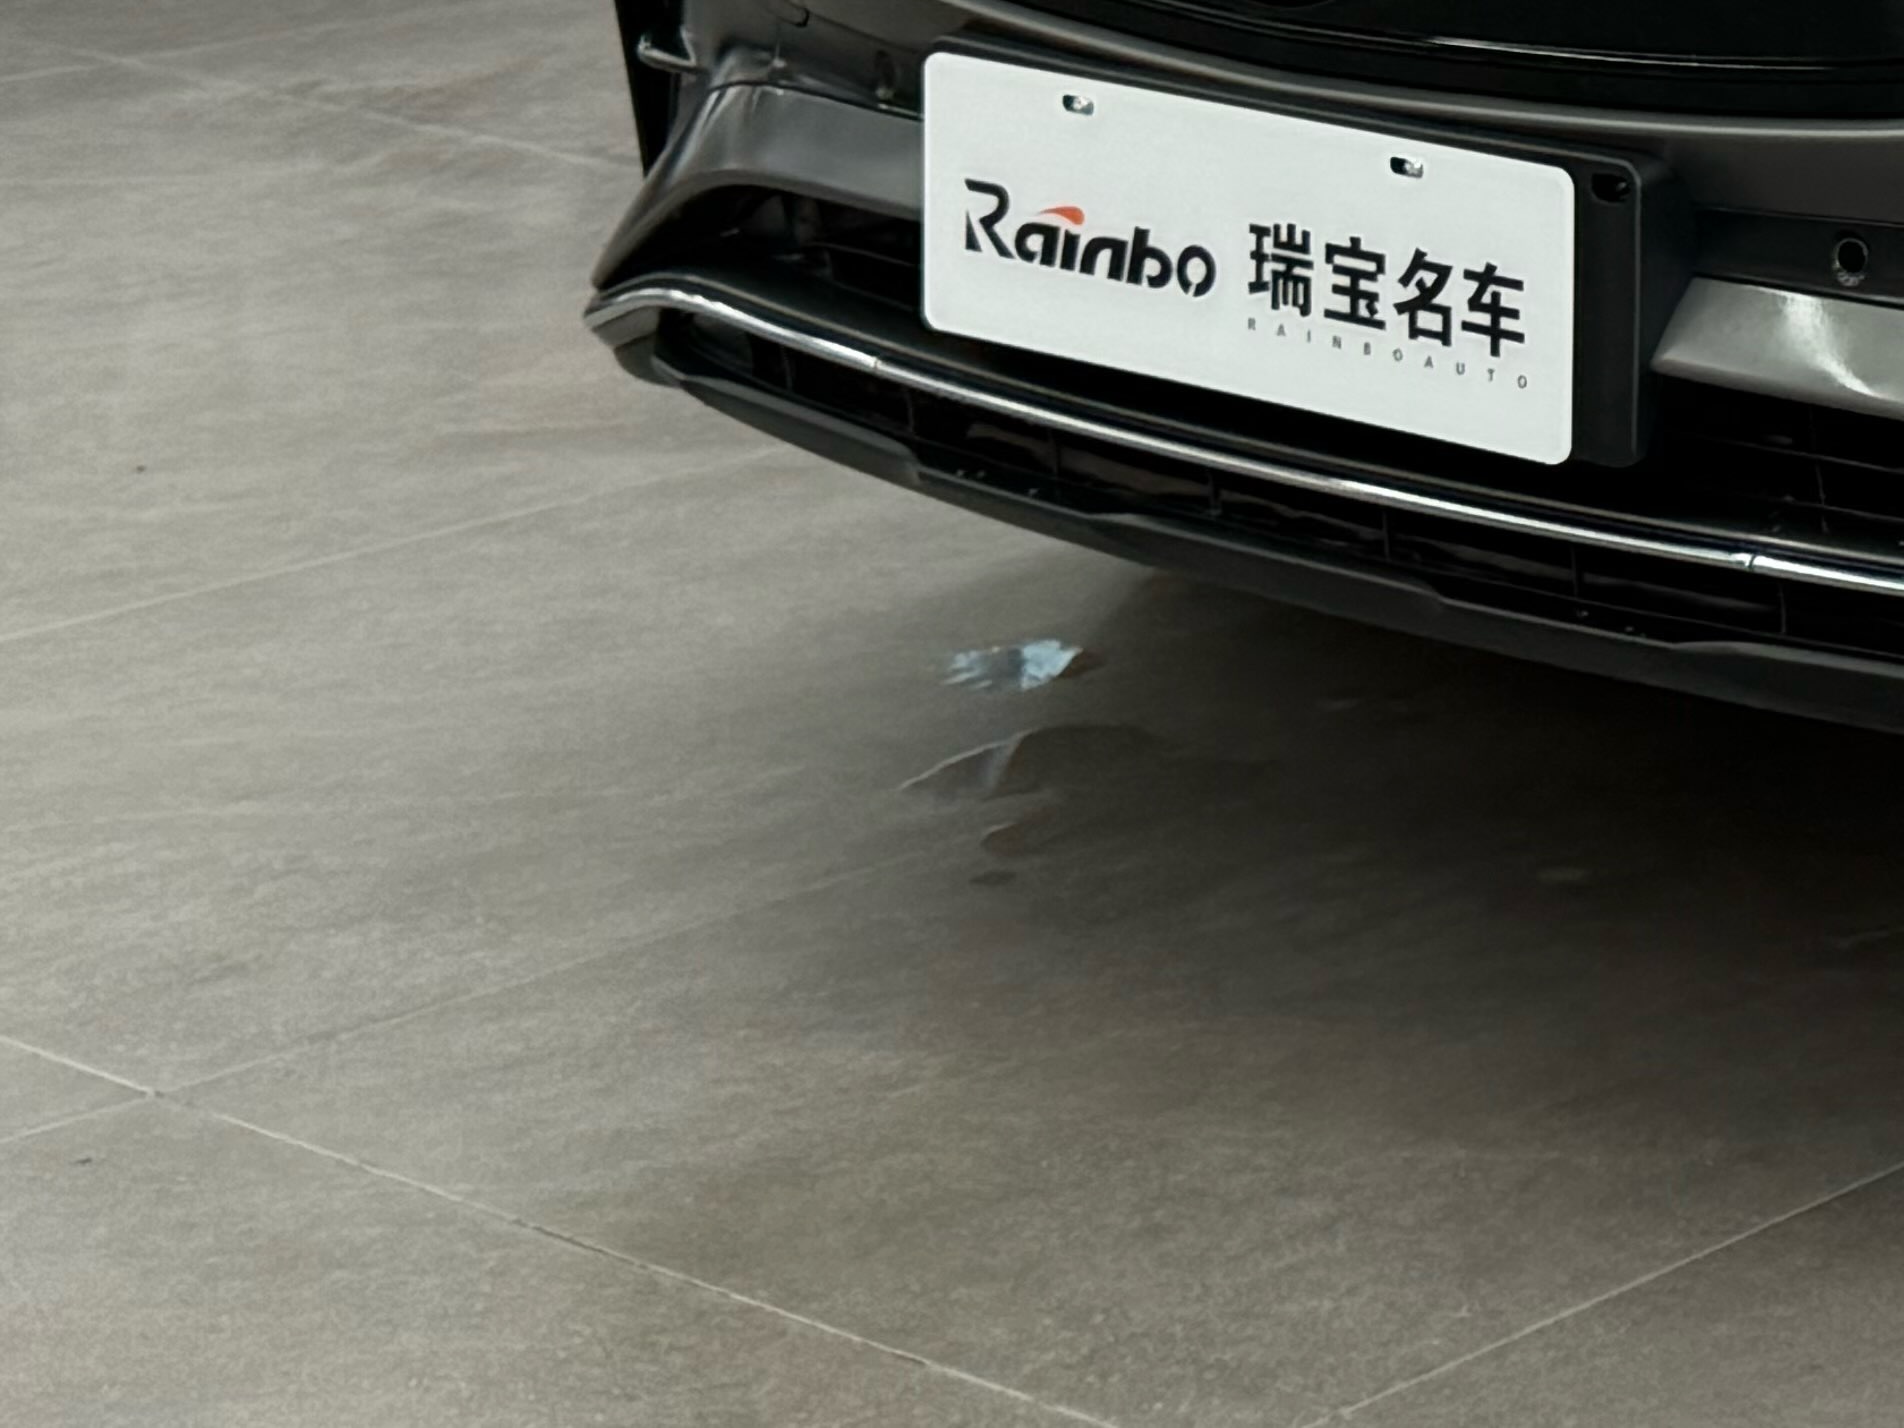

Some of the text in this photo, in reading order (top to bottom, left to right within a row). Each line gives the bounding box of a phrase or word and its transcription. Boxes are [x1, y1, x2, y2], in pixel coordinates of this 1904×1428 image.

[964, 178, 1525, 357] Rainbo 瑞宝名车
[1247, 317, 1528, 389] RAINBOAUTO
